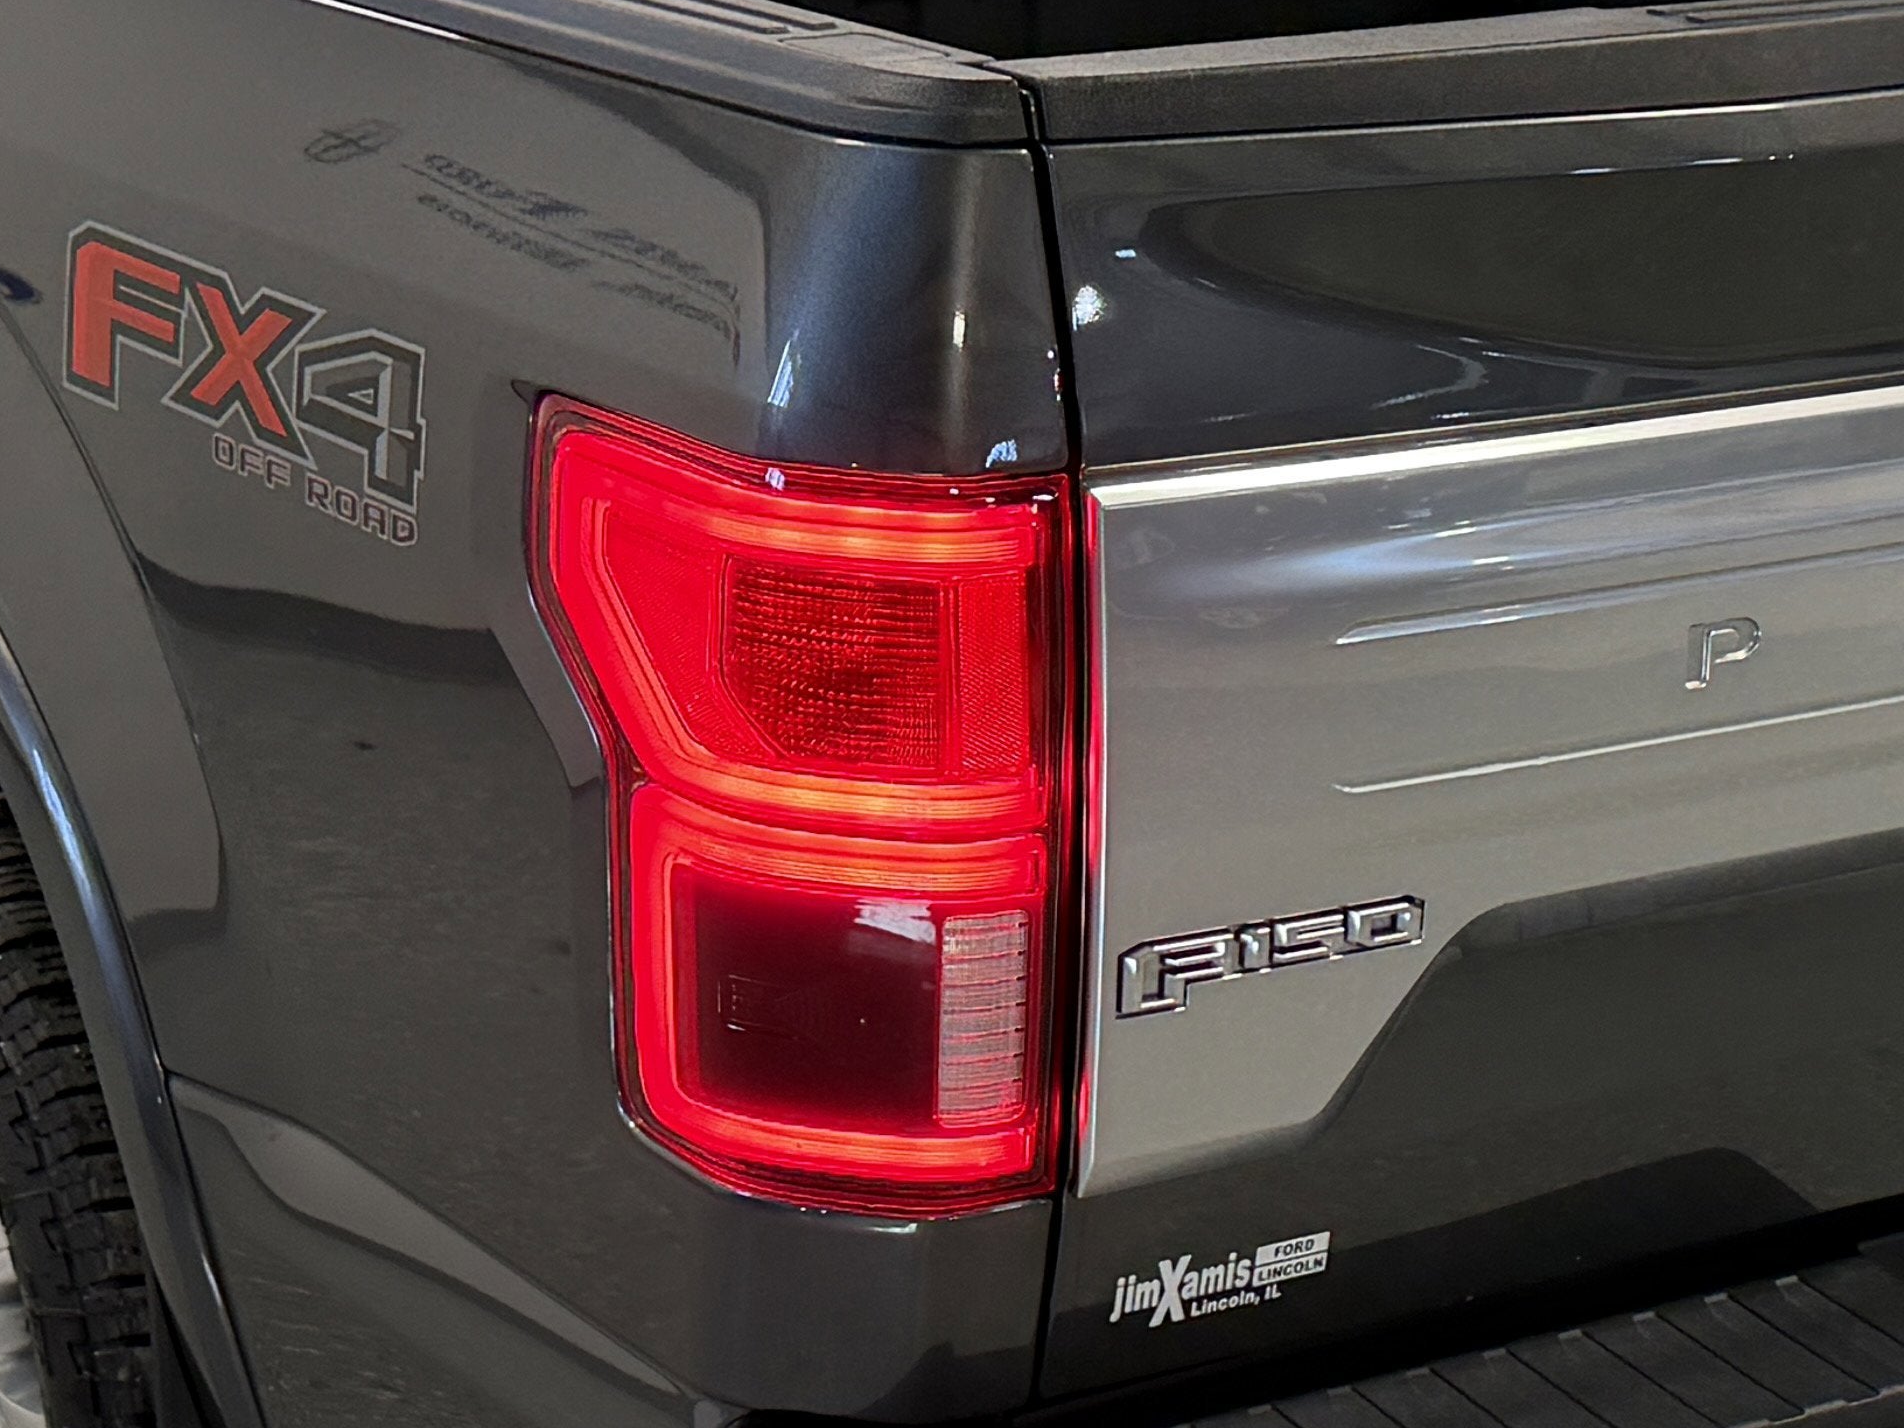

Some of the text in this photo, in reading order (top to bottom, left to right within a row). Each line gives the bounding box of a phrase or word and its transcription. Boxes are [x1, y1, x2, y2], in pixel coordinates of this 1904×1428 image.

[63, 220, 427, 514] FX4
[212, 433, 418, 546] OFF ROAD
[1274, 1238, 1315, 1258] FORD
[1257, 1256, 1325, 1283] LINCOLN
[1190, 1285, 1282, 1317] Lincoln, IL
